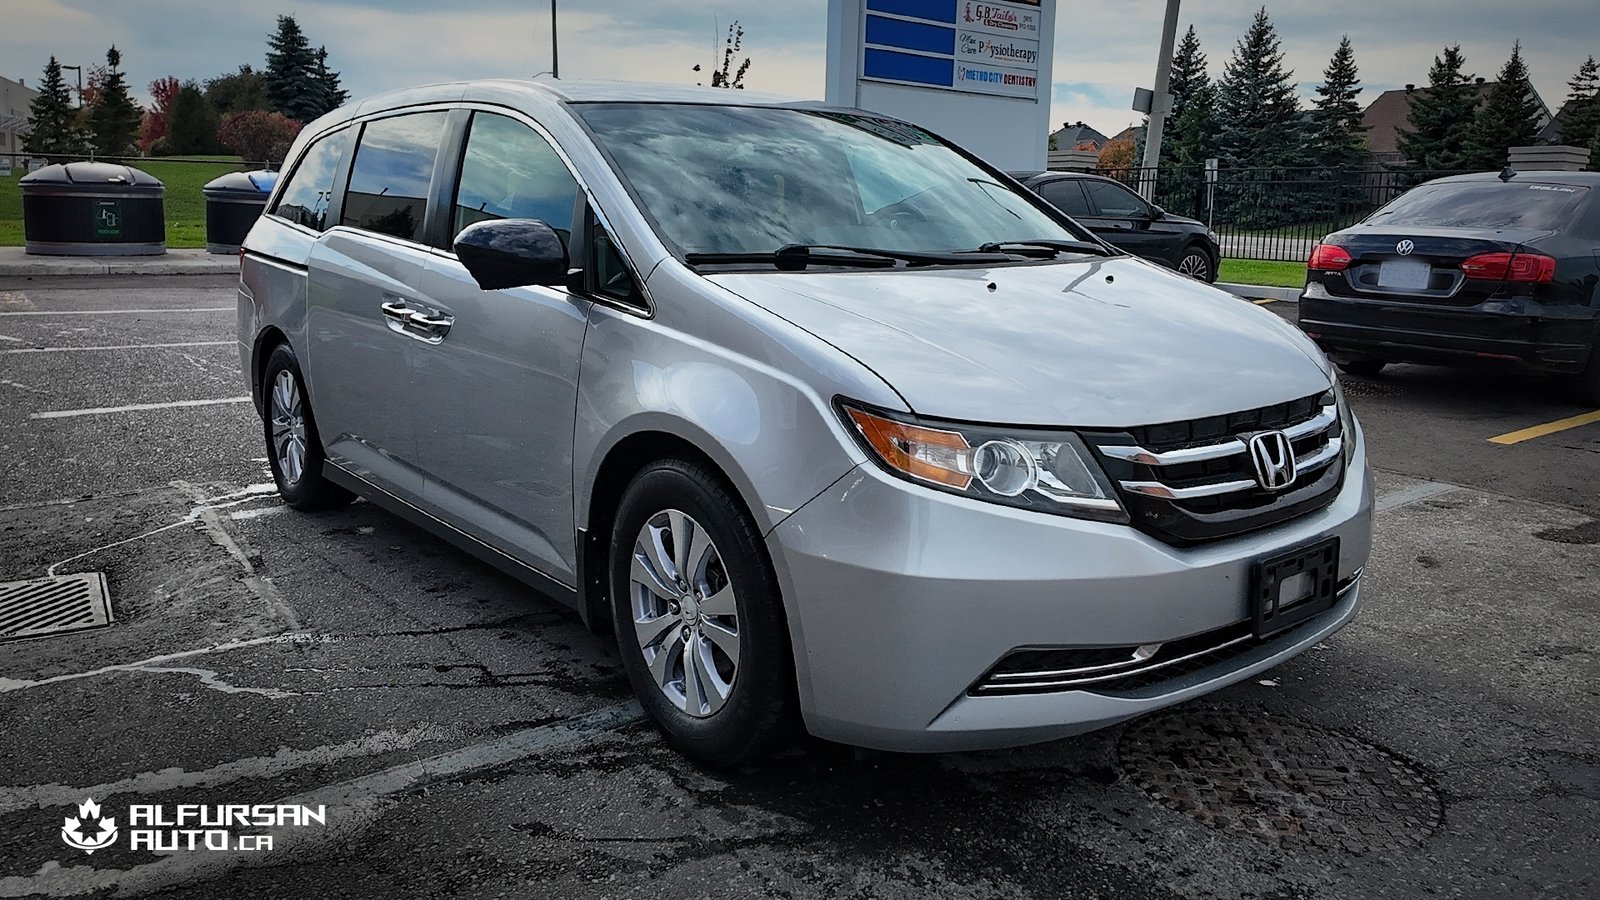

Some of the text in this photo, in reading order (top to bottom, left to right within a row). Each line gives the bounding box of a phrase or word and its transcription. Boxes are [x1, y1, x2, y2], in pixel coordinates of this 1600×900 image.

[961, 43, 977, 54] Care
[966, 69, 1037, 87] METRO CITY DENTISTRY
